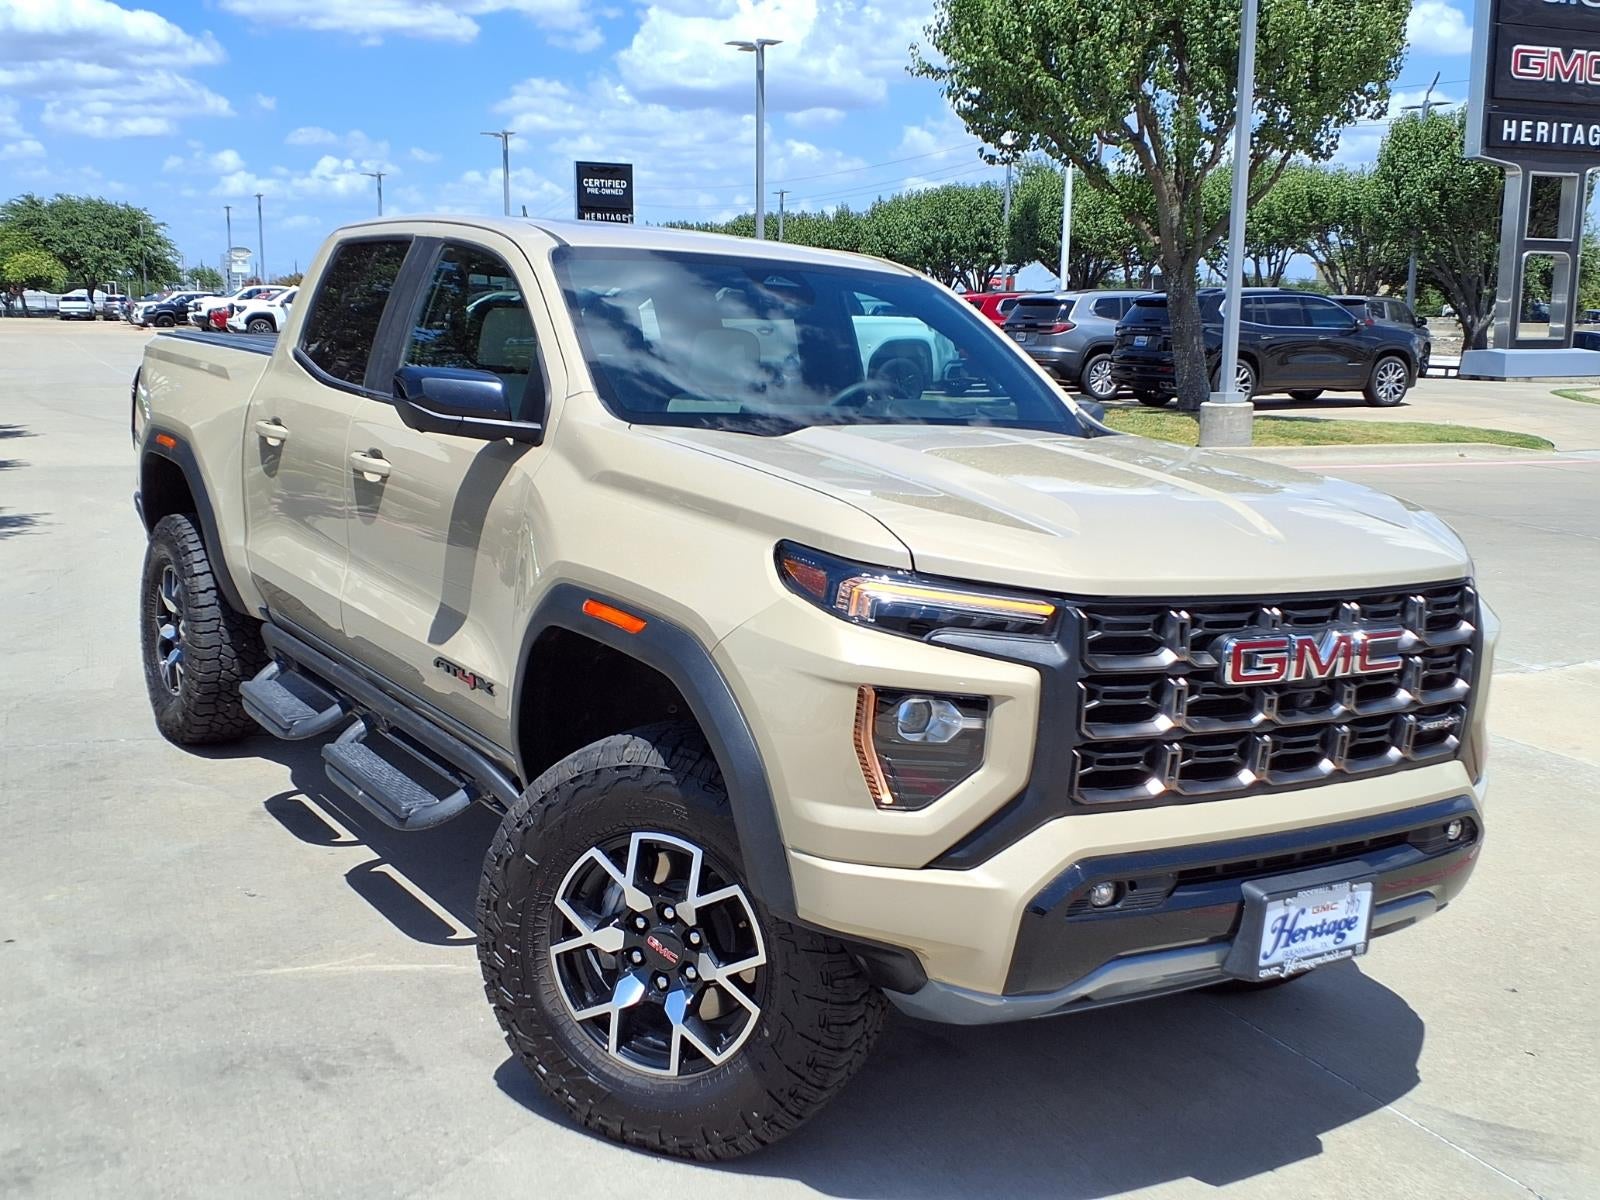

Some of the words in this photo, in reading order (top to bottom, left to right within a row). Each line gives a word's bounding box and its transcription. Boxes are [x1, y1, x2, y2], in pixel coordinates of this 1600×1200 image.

[583, 178, 627, 189] CERTIFIED
[586, 187, 624, 196] PRE-OWNED
[584, 211, 629, 222] HERITAGE
[1224, 629, 1403, 685] GMC
[433, 656, 496, 697] AT4X
[1312, 902, 1340, 915] GMC
[1261, 907, 1360, 961] Heritage
[647, 935, 679, 964] GMC
